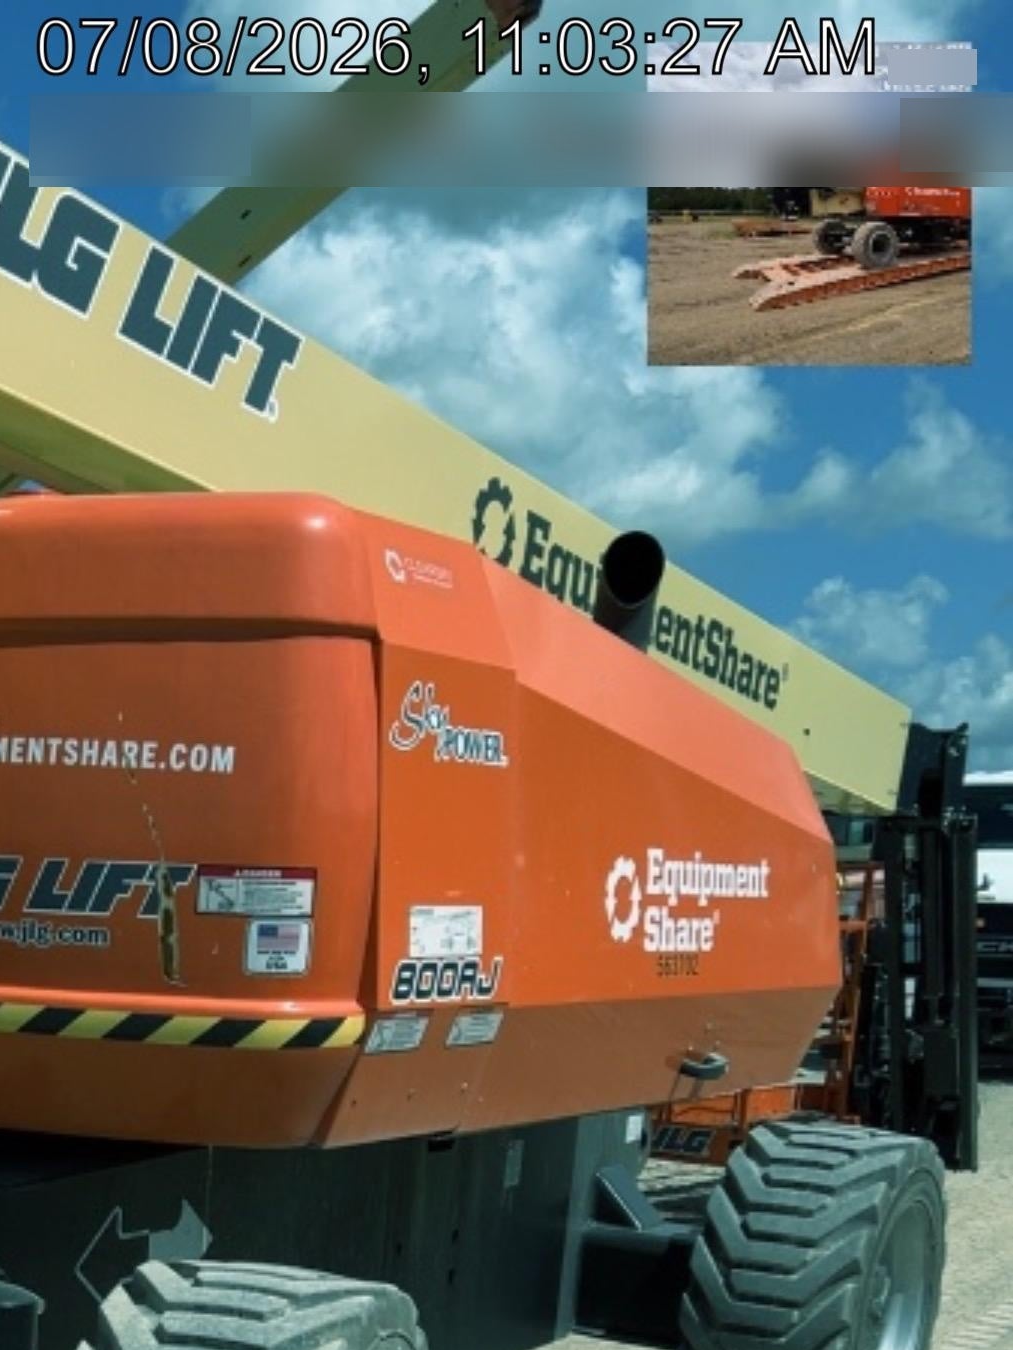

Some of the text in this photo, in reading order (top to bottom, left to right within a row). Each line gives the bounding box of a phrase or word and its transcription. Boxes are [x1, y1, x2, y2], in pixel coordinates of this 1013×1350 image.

[116, 240, 306, 423] LIFT
[22, 857, 198, 919] LIFT
[646, 847, 771, 907] Equipment
[643, 905, 715, 952] Share
[390, 955, 504, 1006] 800AJ
